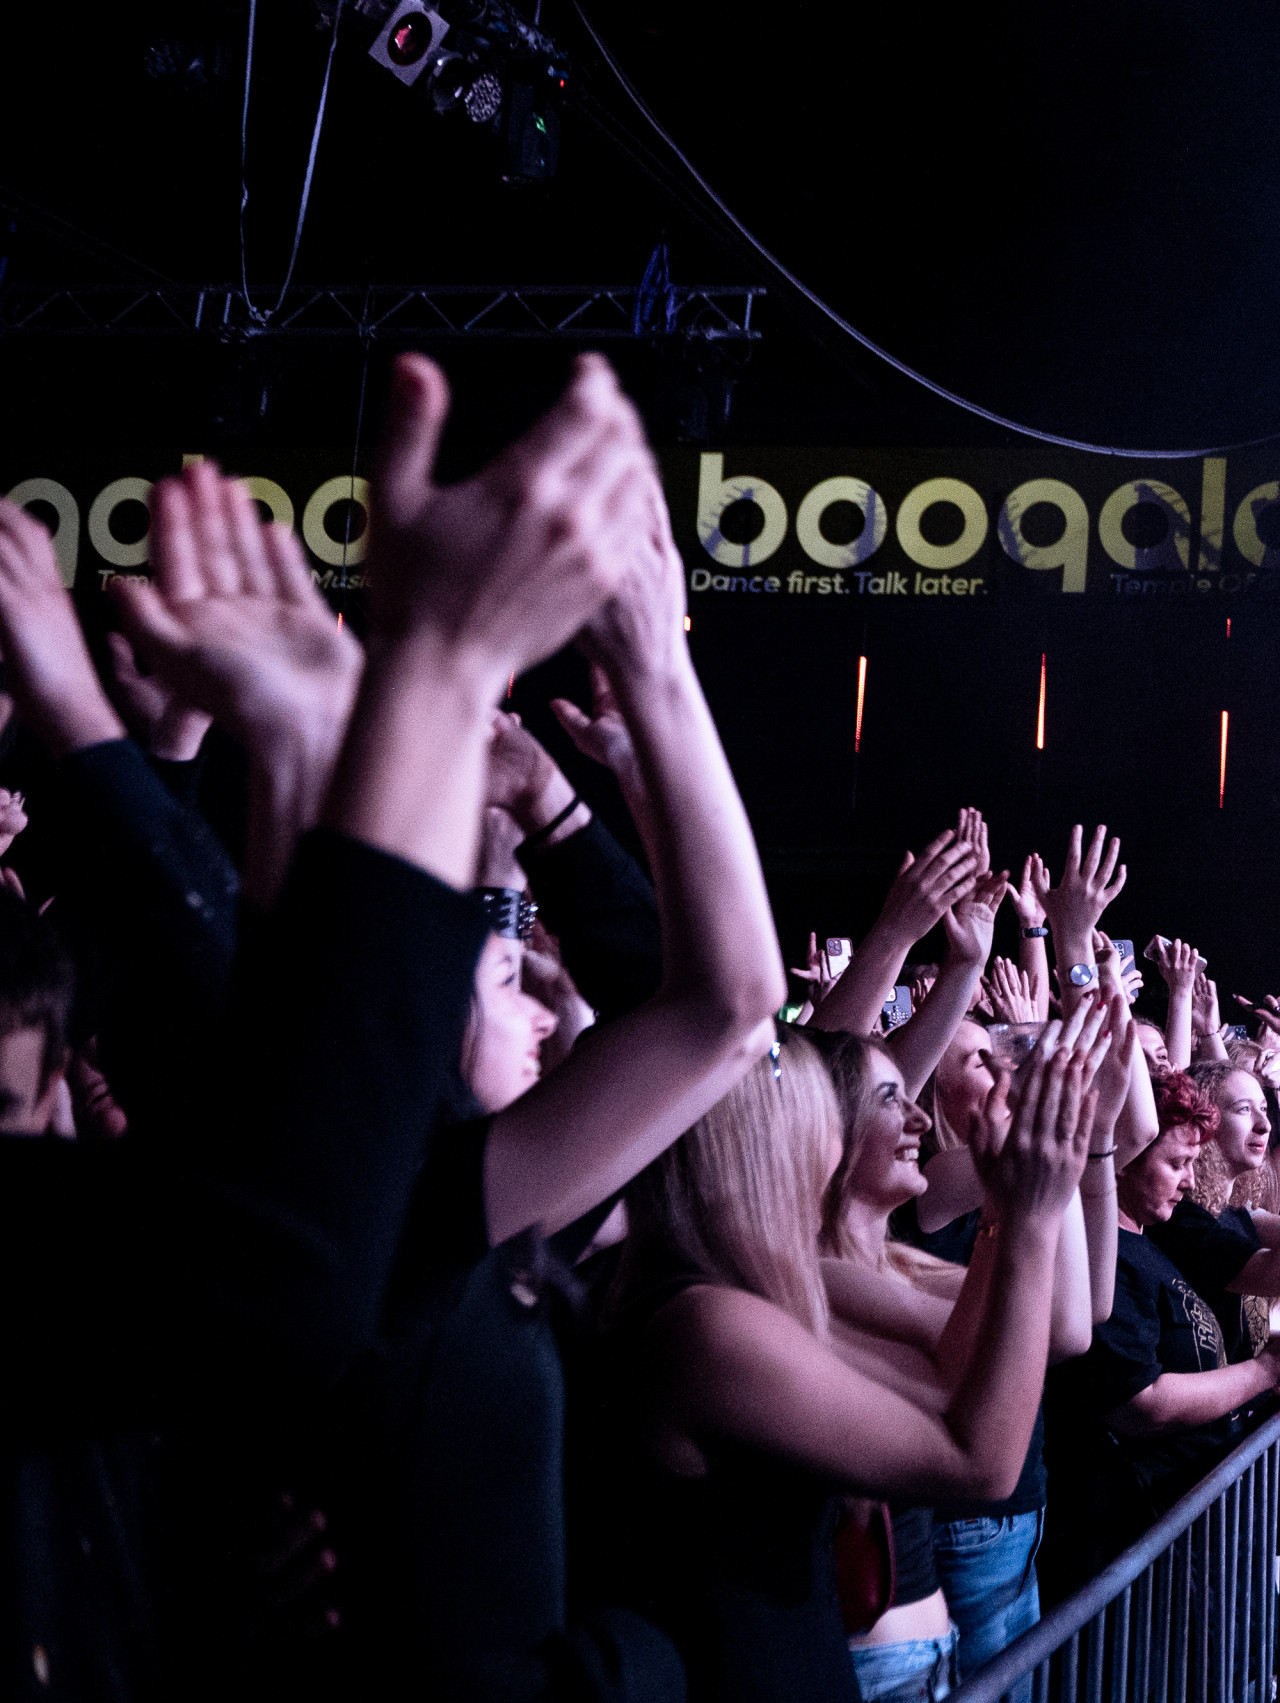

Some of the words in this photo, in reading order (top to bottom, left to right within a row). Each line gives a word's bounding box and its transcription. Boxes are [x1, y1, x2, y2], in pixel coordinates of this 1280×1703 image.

[690, 568, 781, 594] Dance
[787, 570, 850, 595] first.
[854, 571, 908, 595] Talk
[914, 571, 988, 597] later.
